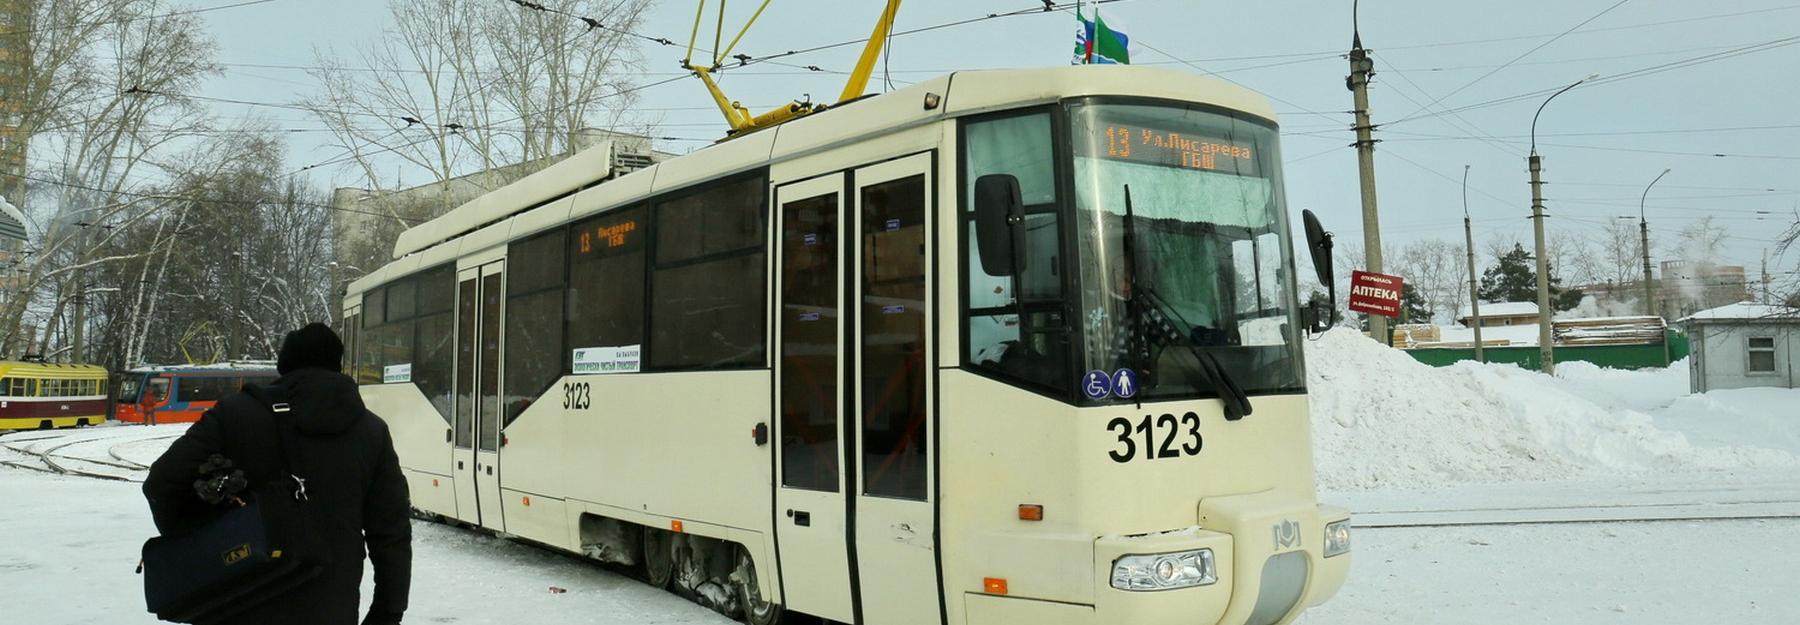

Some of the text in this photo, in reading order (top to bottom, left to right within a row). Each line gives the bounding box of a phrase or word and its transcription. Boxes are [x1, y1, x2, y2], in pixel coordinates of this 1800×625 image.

[1106, 127, 1130, 157] 13
[1182, 151, 1216, 170] ГБШ
[580, 232, 591, 252] 13
[1352, 285, 1398, 301] АПТЕКА
[563, 382, 590, 410] 3123
[1106, 411, 1203, 463] 3123
